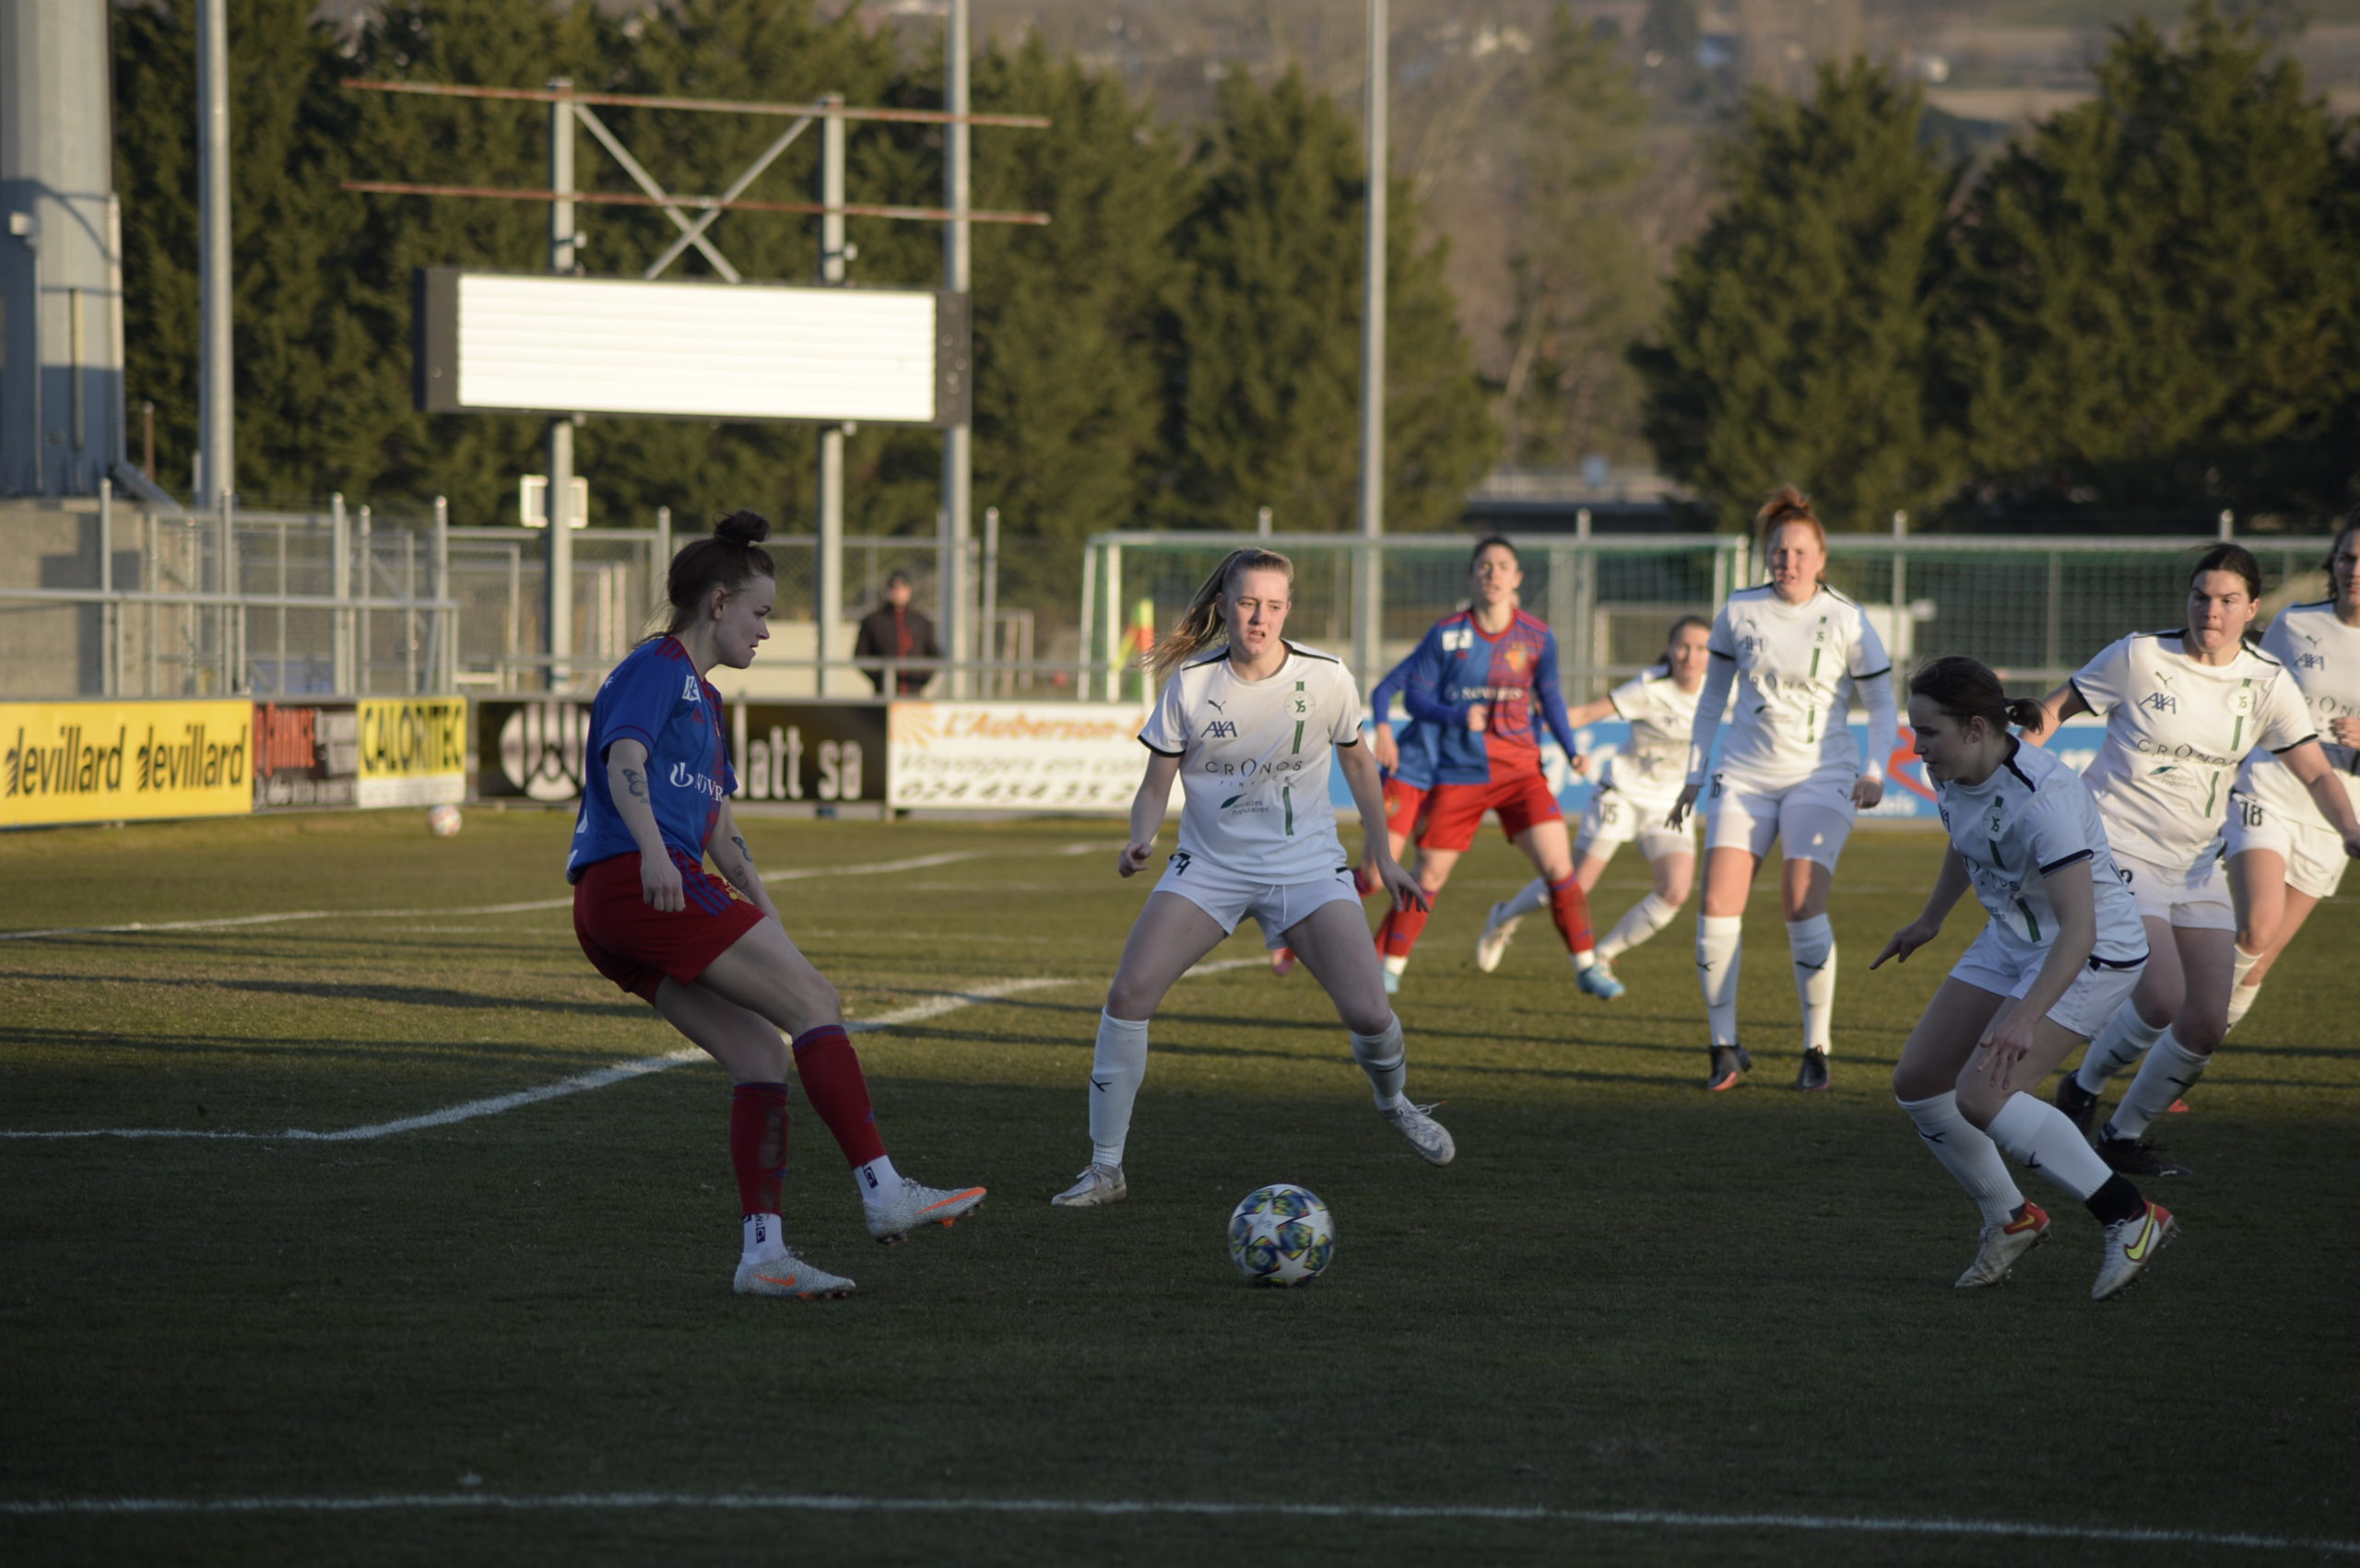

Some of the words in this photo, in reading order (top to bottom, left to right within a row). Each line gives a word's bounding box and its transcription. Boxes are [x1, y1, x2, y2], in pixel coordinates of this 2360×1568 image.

[2140, 692, 2177, 714] AXA
[362, 704, 463, 772] CALORITEC
[1200, 721, 1237, 738] AXA
[6, 725, 126, 797] devillard
[136, 724, 247, 793] devillard
[817, 739, 863, 800] sa
[1205, 759, 1302, 776] CRONOS
[2240, 800, 2262, 827] 18
